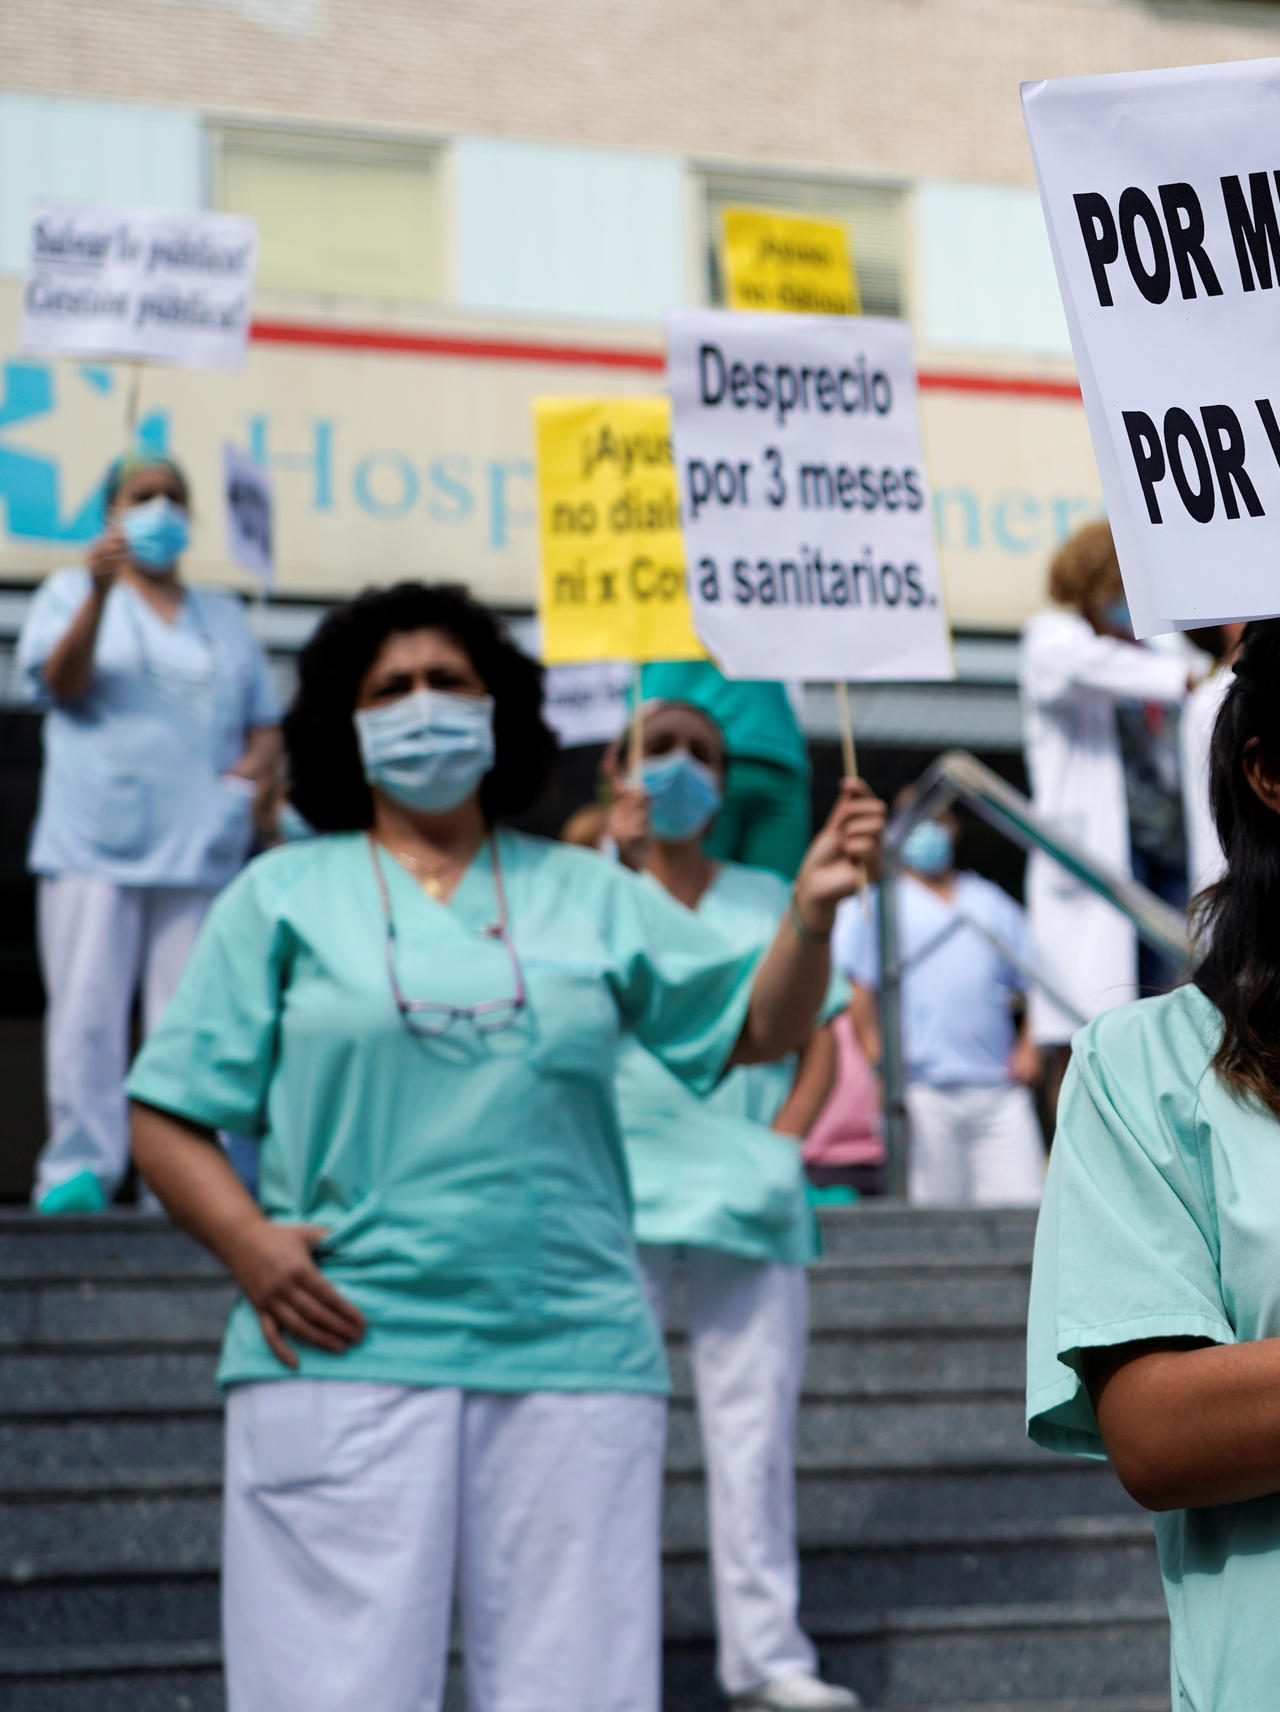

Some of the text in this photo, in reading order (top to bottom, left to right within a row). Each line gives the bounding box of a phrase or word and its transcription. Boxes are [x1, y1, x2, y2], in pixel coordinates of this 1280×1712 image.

[1072, 182, 1224, 307] POR
[697, 341, 894, 426] Desprecio
[686, 446, 924, 521] por 3 meses
[1121, 404, 1266, 525] POR
[551, 501, 599, 538] no
[697, 545, 937, 609] a sanitarios.
